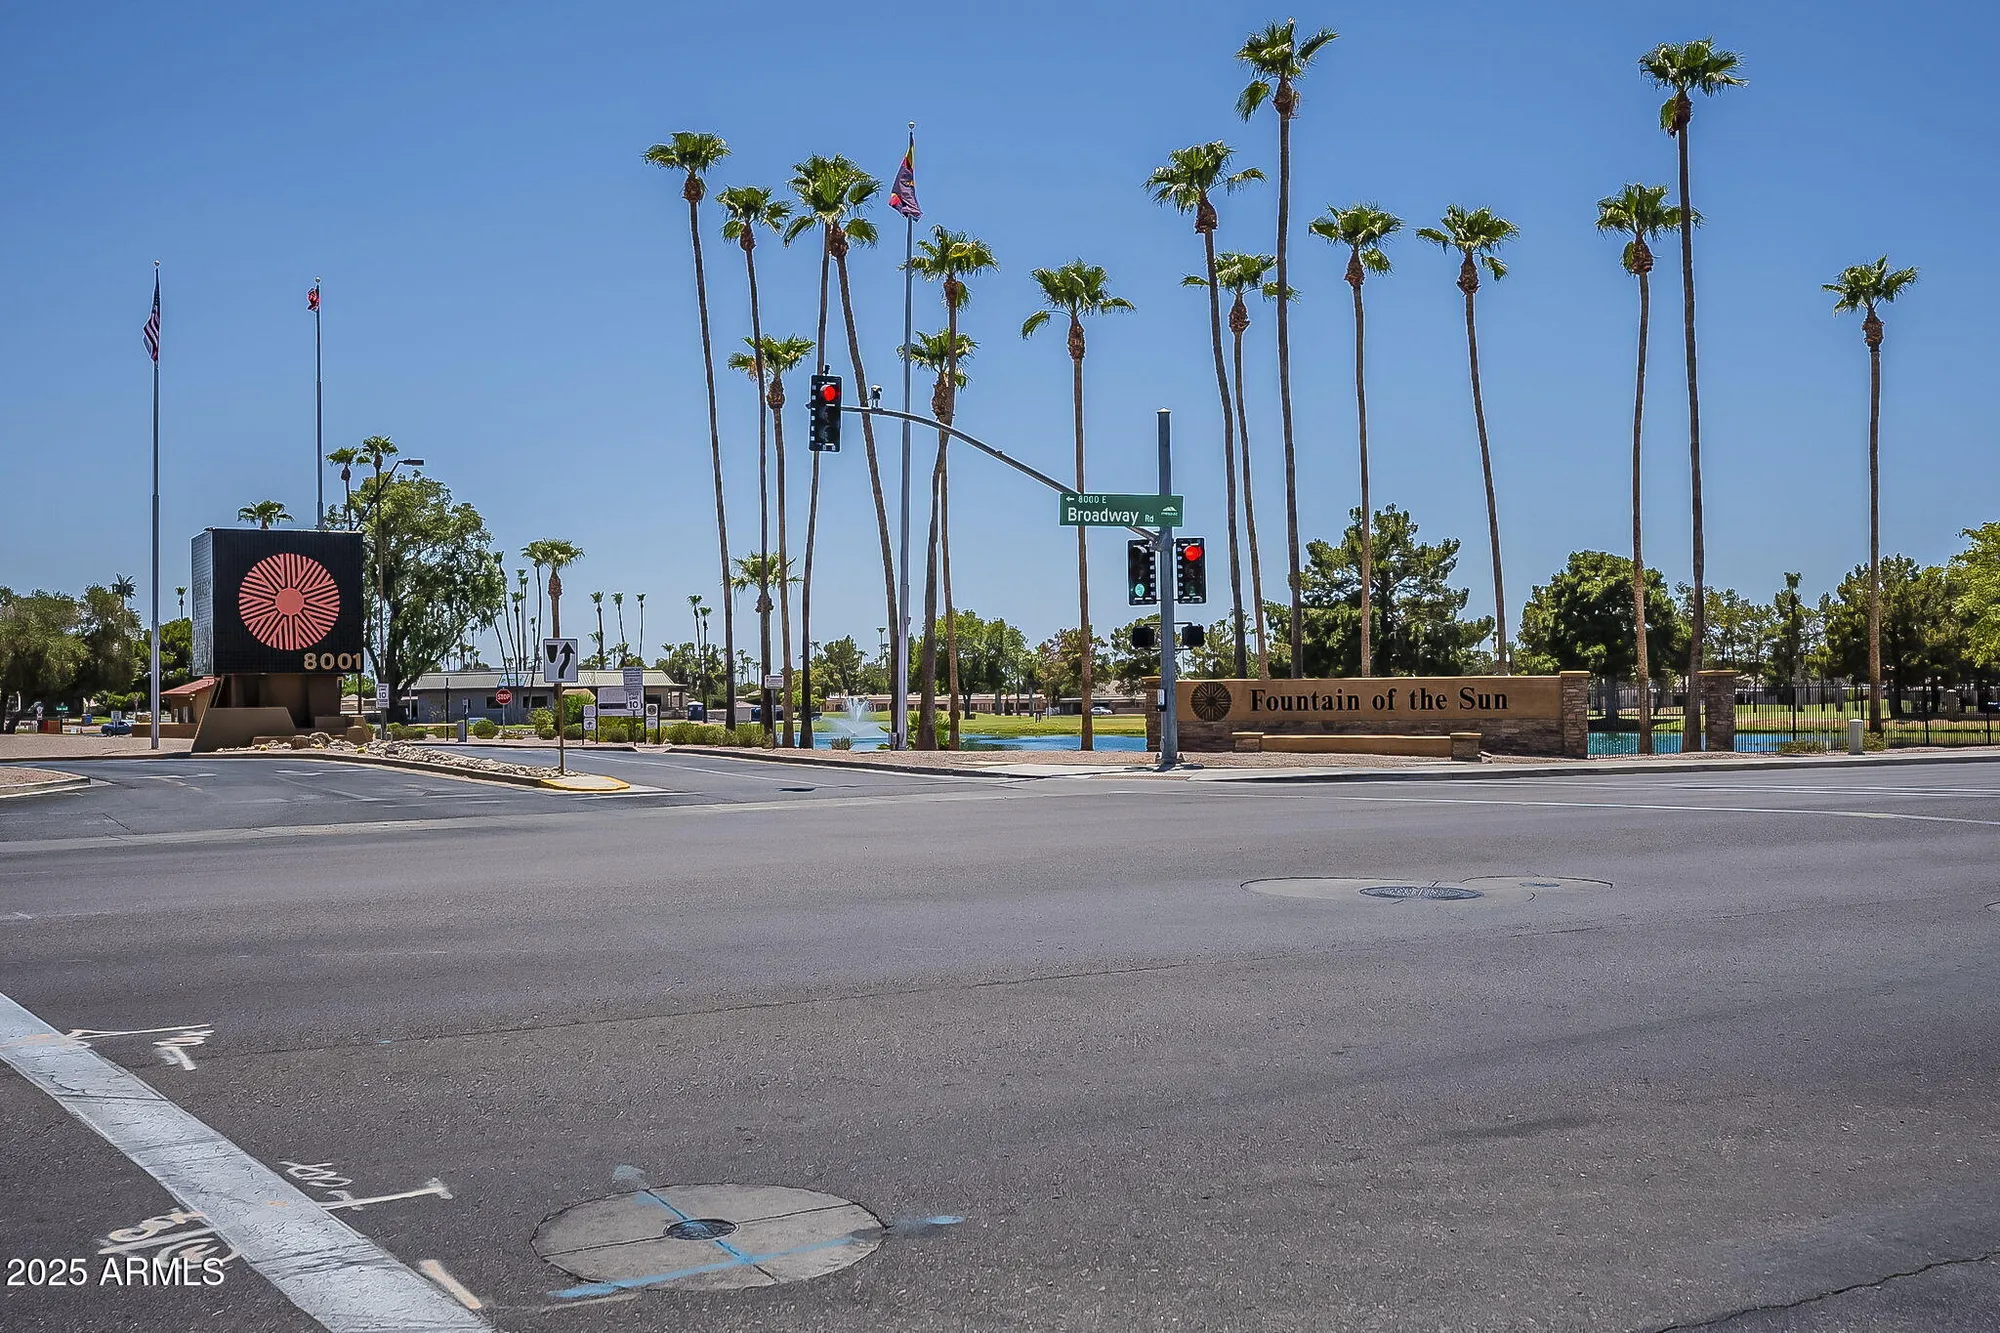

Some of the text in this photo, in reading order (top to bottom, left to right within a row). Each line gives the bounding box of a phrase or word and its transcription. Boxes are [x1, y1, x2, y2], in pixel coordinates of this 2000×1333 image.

[1078, 495, 1107, 504] 8000 E
[1067, 507, 1139, 526] Broadway
[1144, 514, 1155, 523] Rd
[303, 652, 361, 670] 8001
[629, 701, 639, 709] 10
[1250, 686, 1509, 712] Fountain of the Sun
